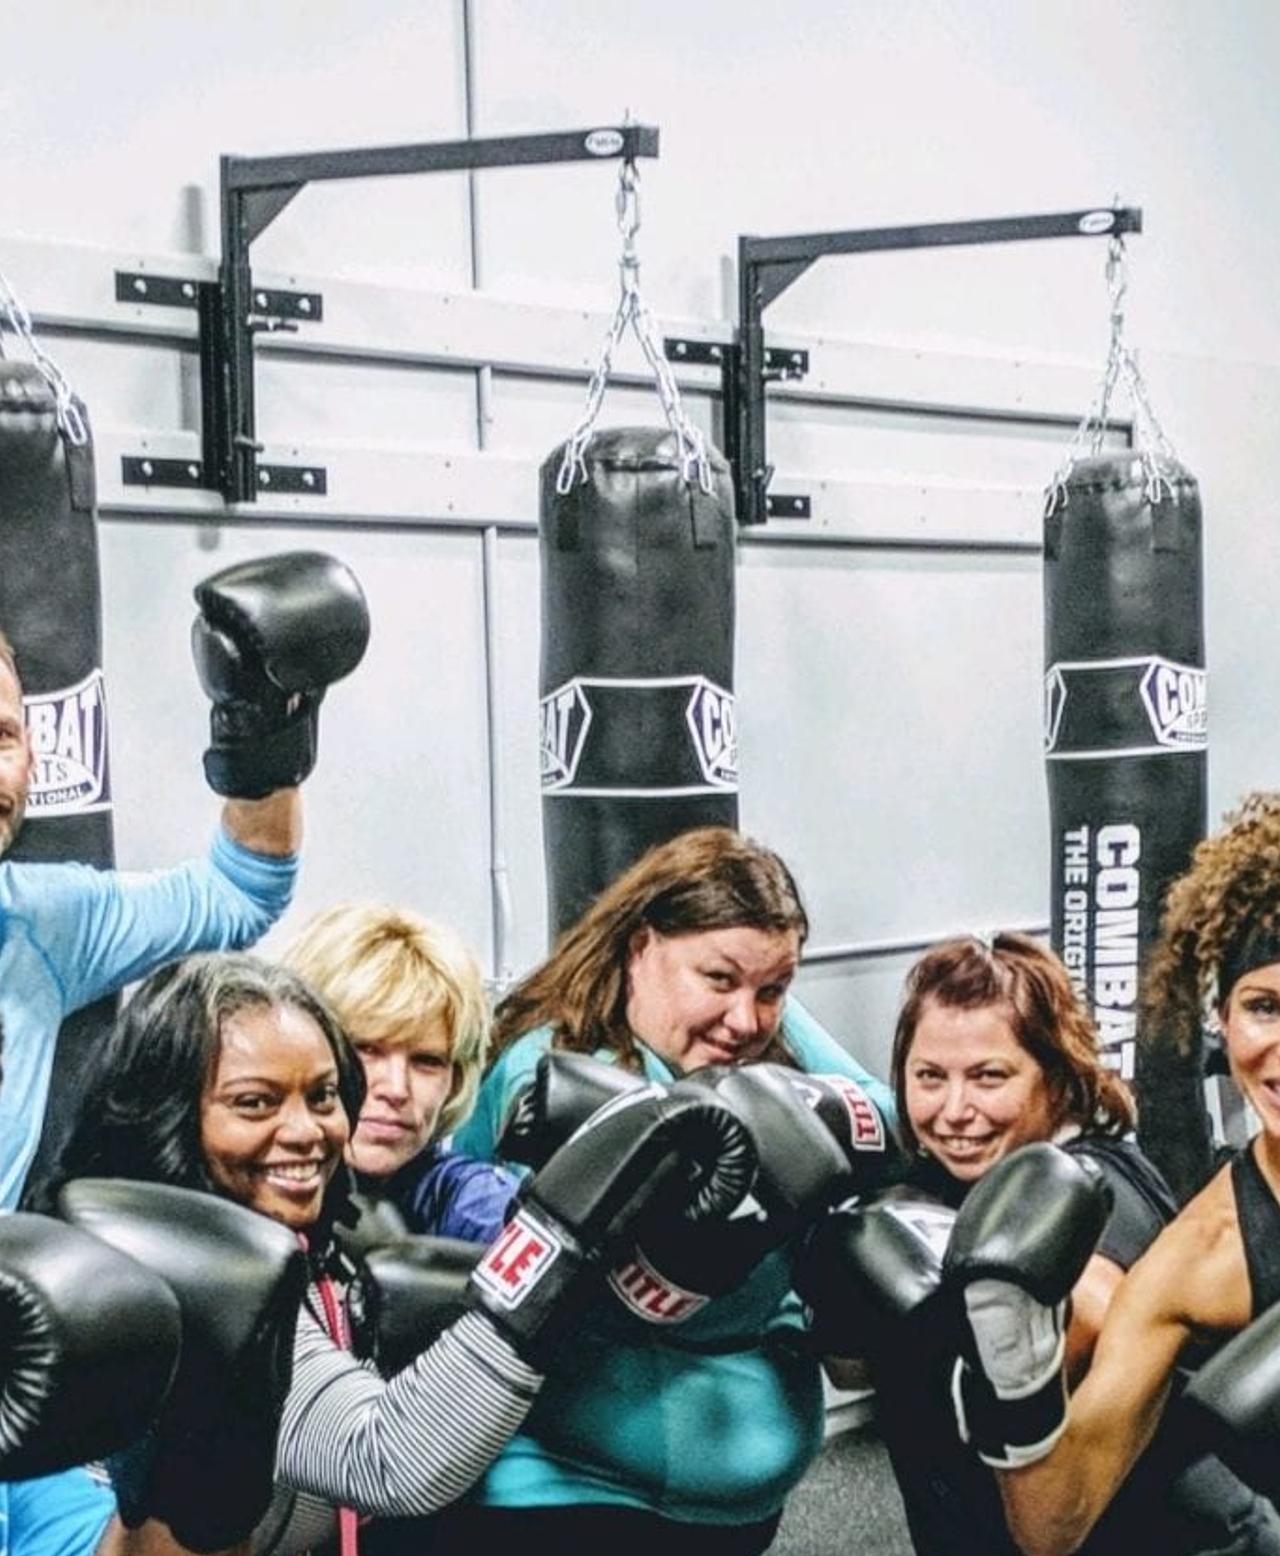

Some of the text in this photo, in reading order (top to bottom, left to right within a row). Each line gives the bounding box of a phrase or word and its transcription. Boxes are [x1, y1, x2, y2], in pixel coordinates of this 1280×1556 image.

[22, 684, 98, 774] BAT
[1064, 825, 1090, 1006] THE ORIGIN
[1094, 823, 1141, 1081] COMBAT
